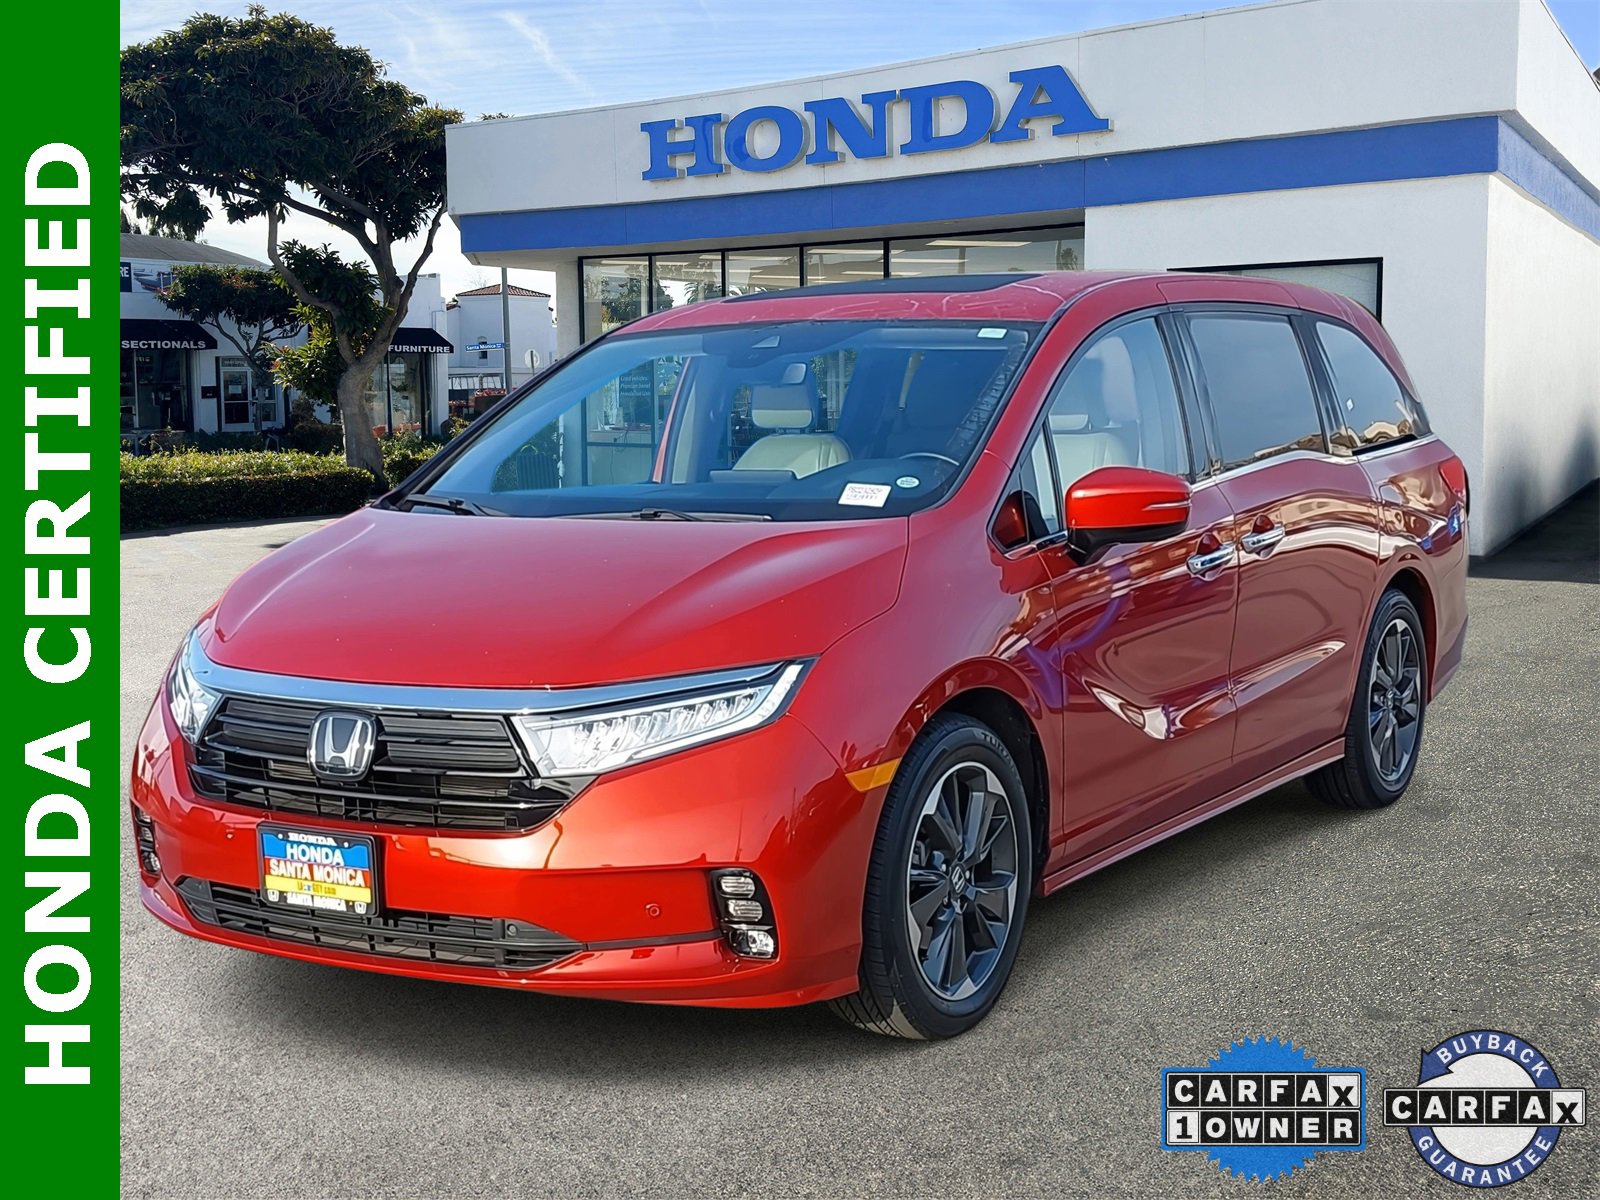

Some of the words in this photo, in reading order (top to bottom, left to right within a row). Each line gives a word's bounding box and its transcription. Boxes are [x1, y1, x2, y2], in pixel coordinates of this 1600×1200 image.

[641, 64, 1112, 182] HONDA
[121, 340, 206, 349] SECTIONALS
[388, 345, 450, 353] FURNITURE
[286, 843, 344, 866] HONDA
[269, 858, 311, 880] SANTA
[313, 864, 365, 887] MONICA
